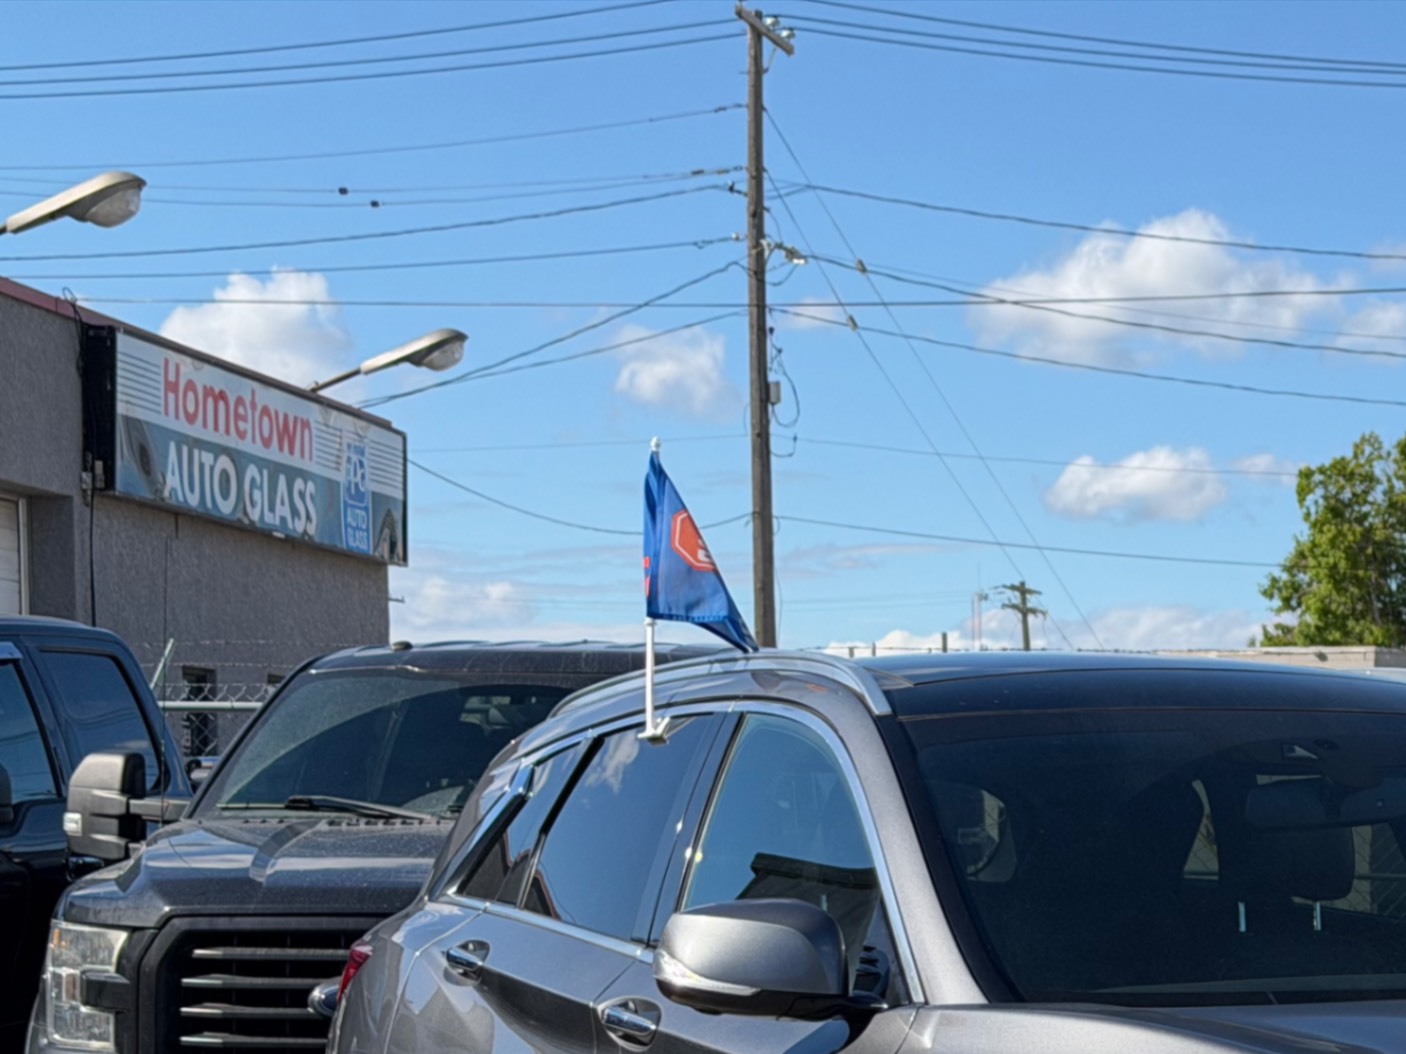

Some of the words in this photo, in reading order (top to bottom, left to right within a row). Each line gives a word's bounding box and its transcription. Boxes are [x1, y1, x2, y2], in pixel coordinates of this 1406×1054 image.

[163, 357, 315, 463] Hometown
[163, 440, 237, 515] AUTO
[243, 463, 317, 536] GLASS
[346, 507, 367, 530] AUTO
